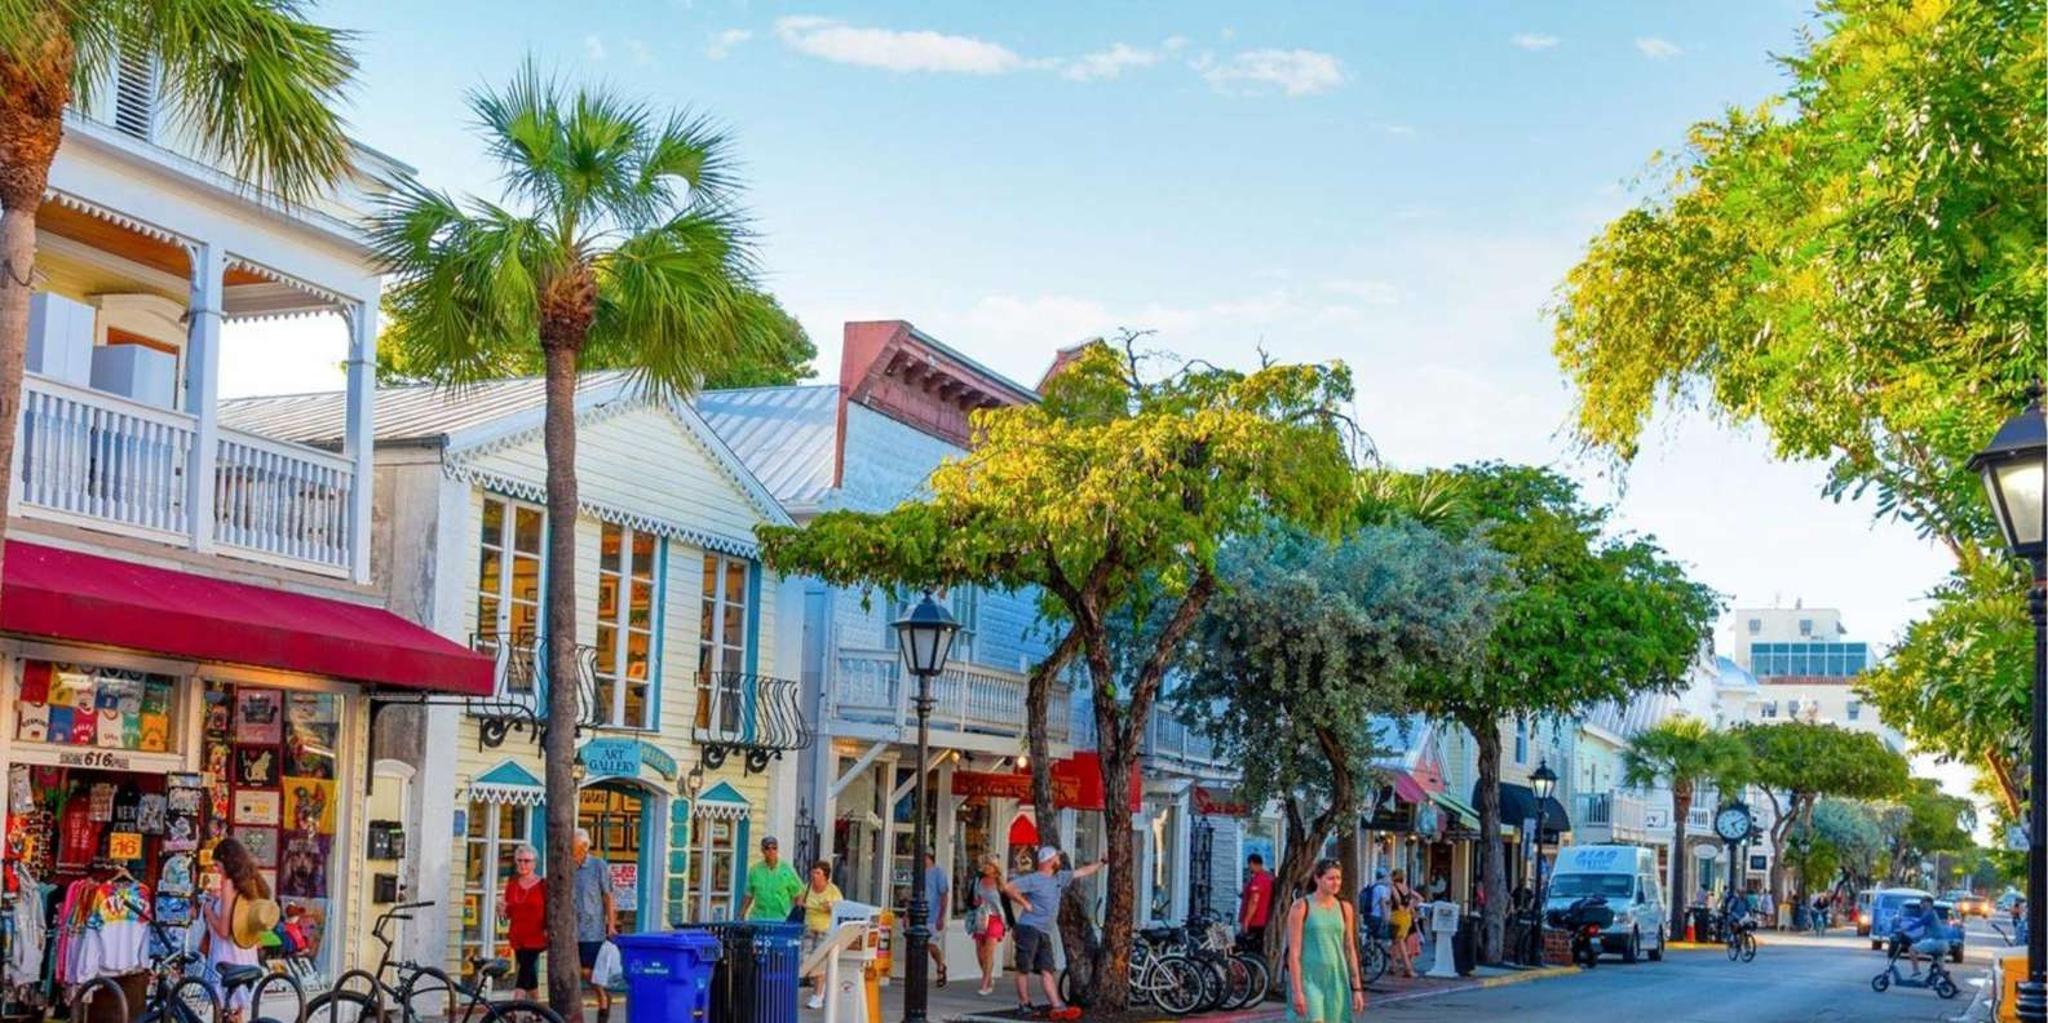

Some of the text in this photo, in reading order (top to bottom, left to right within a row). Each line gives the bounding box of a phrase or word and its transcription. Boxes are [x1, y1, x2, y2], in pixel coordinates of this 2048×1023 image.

[84, 751, 114, 768] 616
[603, 748, 625, 760] ART
[589, 760, 636, 773] GALLERY
